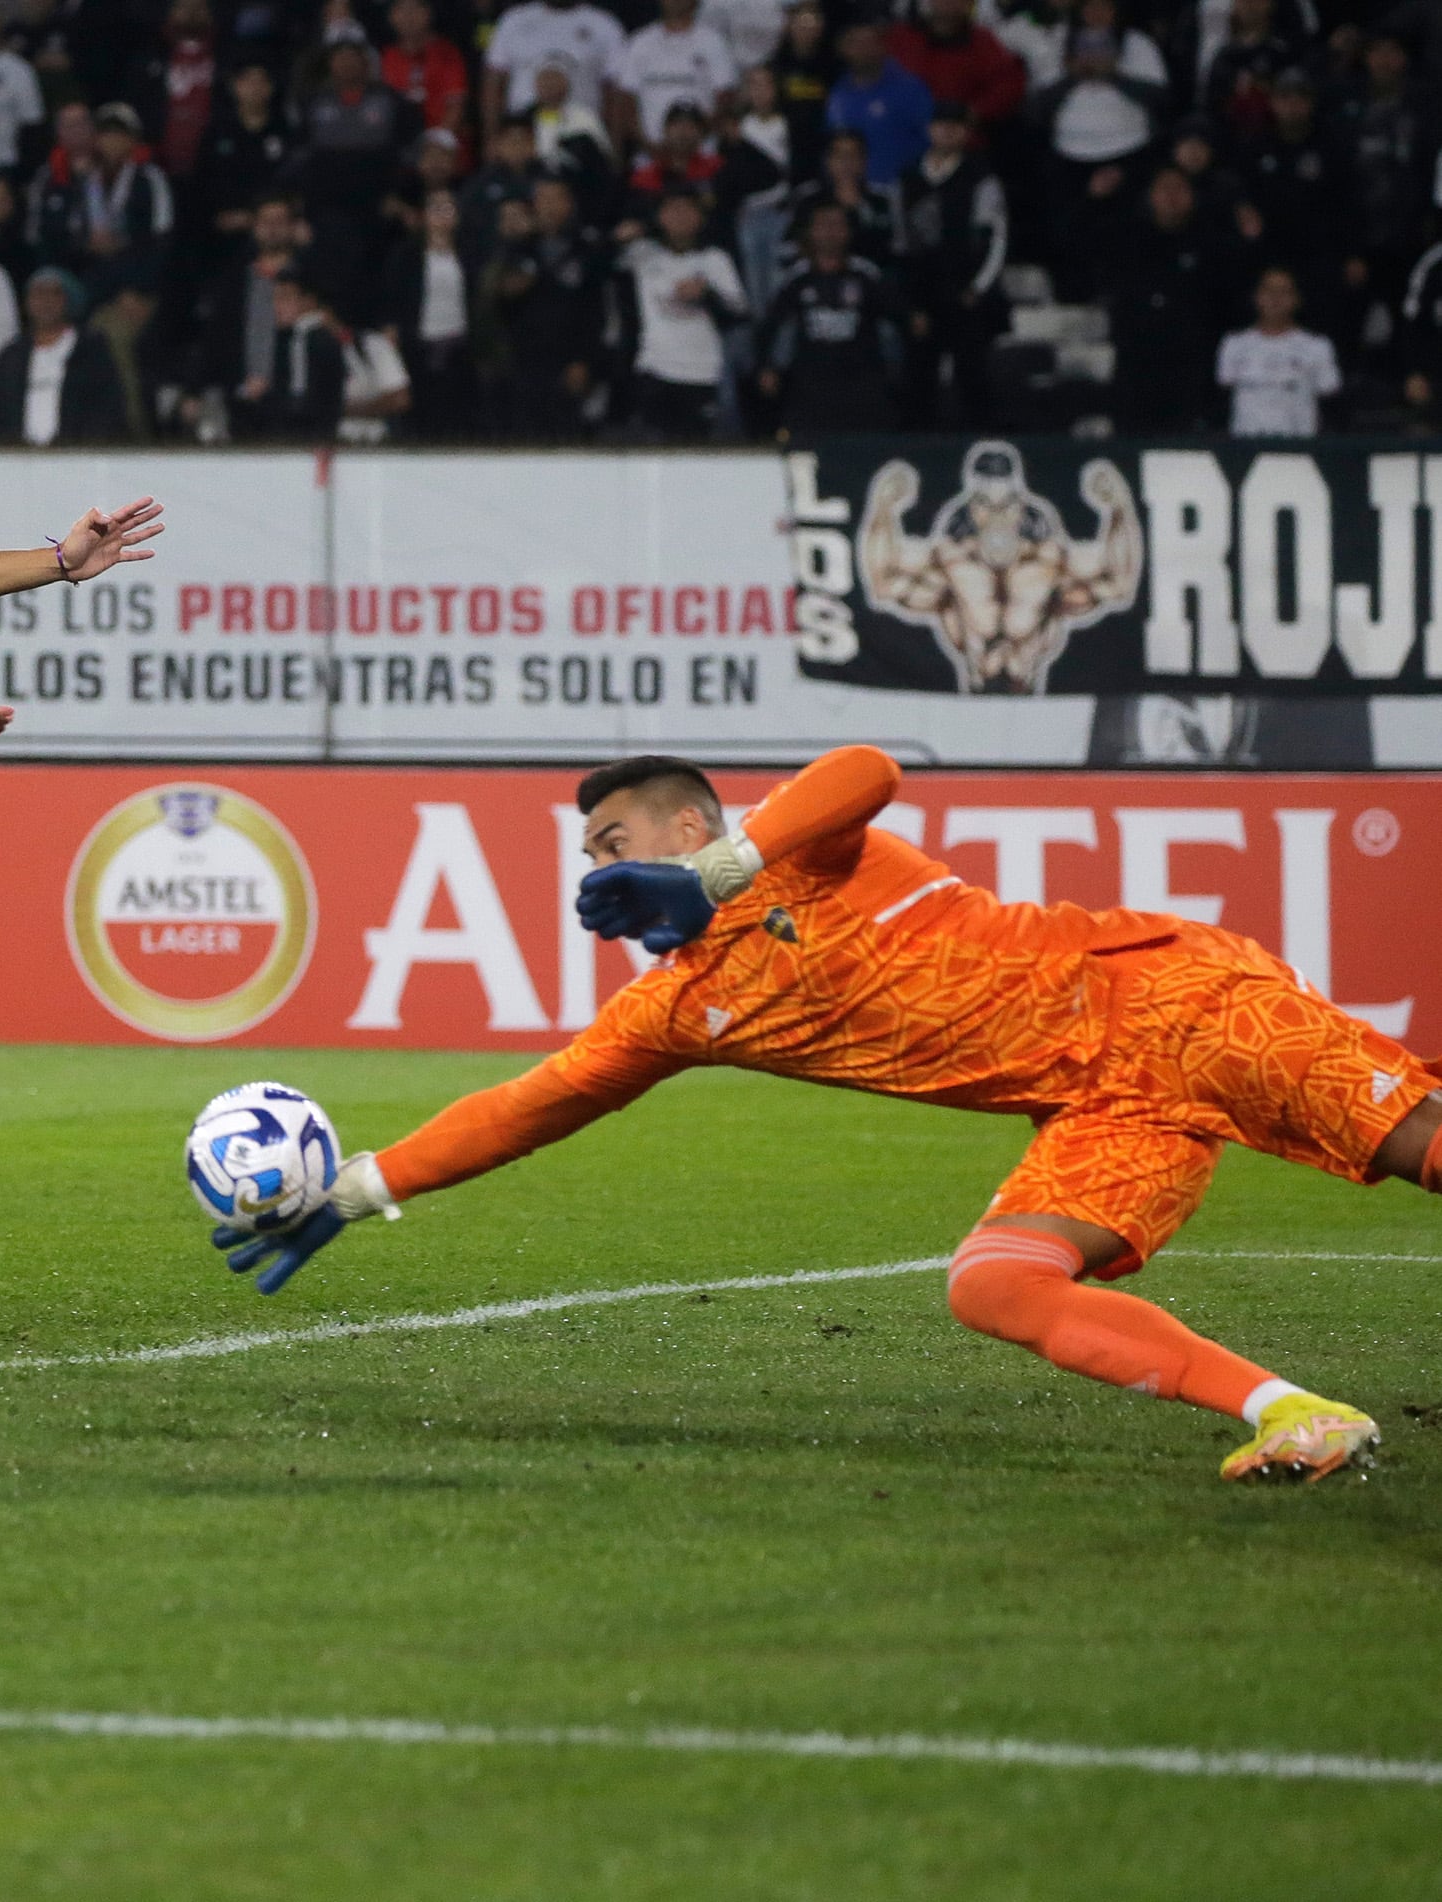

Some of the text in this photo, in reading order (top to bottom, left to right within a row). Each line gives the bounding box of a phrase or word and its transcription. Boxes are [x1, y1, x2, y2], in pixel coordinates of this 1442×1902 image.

[790, 453, 858, 665] LOS
[1140, 449, 1442, 679] ROJ
[62, 584, 156, 634] LOS
[177, 584, 544, 635] PRODUCTOS
[3, 653, 757, 705] LOS ENCUENTRAS SOLO EN
[116, 875, 268, 912] AMSTEL
[139, 924, 242, 954] LAGER
